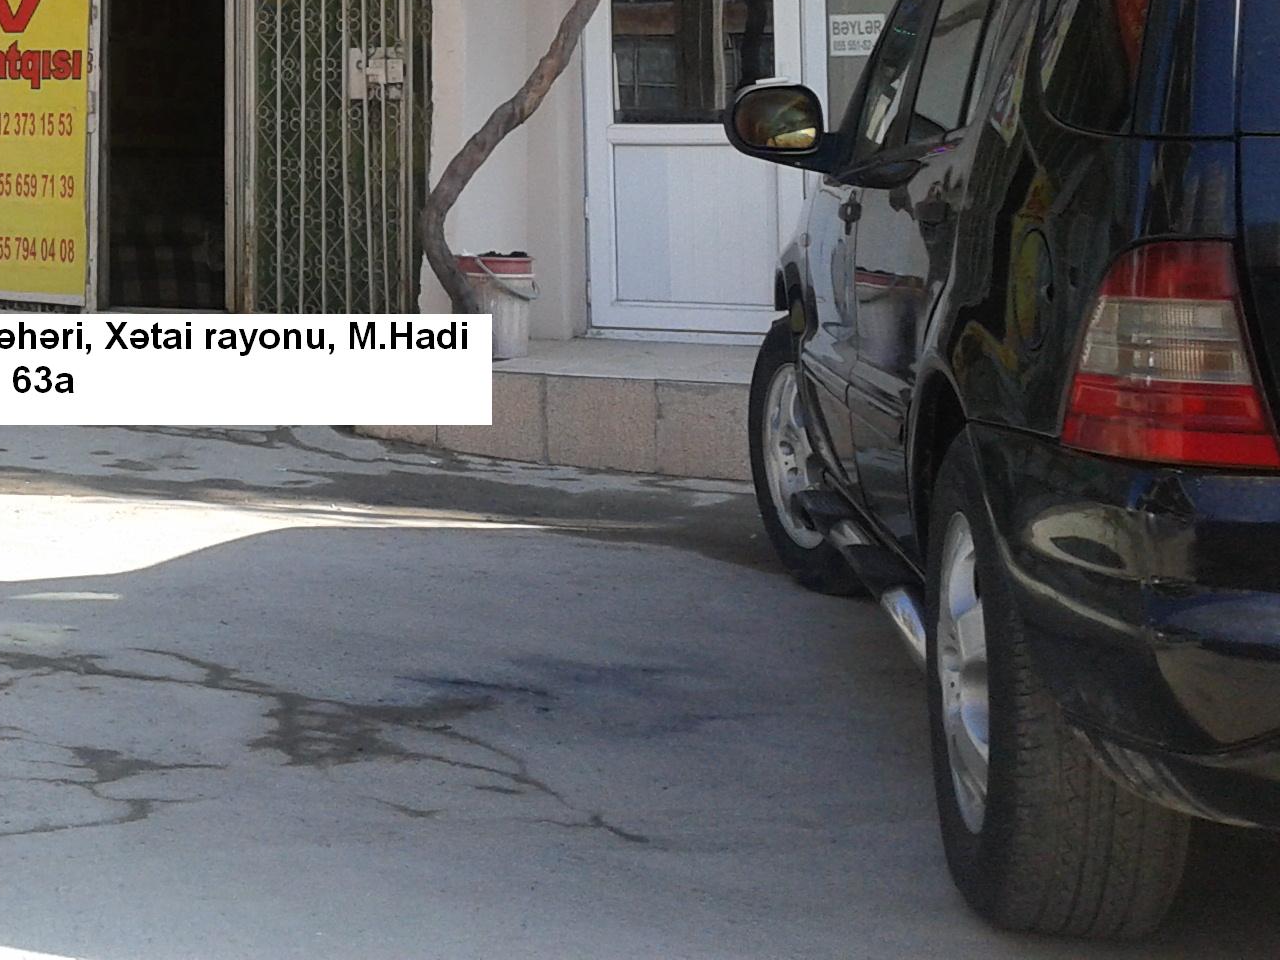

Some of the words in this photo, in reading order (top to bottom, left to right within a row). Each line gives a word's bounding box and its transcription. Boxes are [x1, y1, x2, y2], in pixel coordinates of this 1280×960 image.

[14, 112, 36, 136] 373
[40, 112, 55, 136] 15
[58, 112, 73, 136] 53
[15, 173, 37, 198] 659
[41, 174, 55, 198] 71
[60, 175, 75, 199] 39
[15, 237, 36, 261] 794
[41, 238, 56, 262] 04
[60, 239, 75, 263] 08
